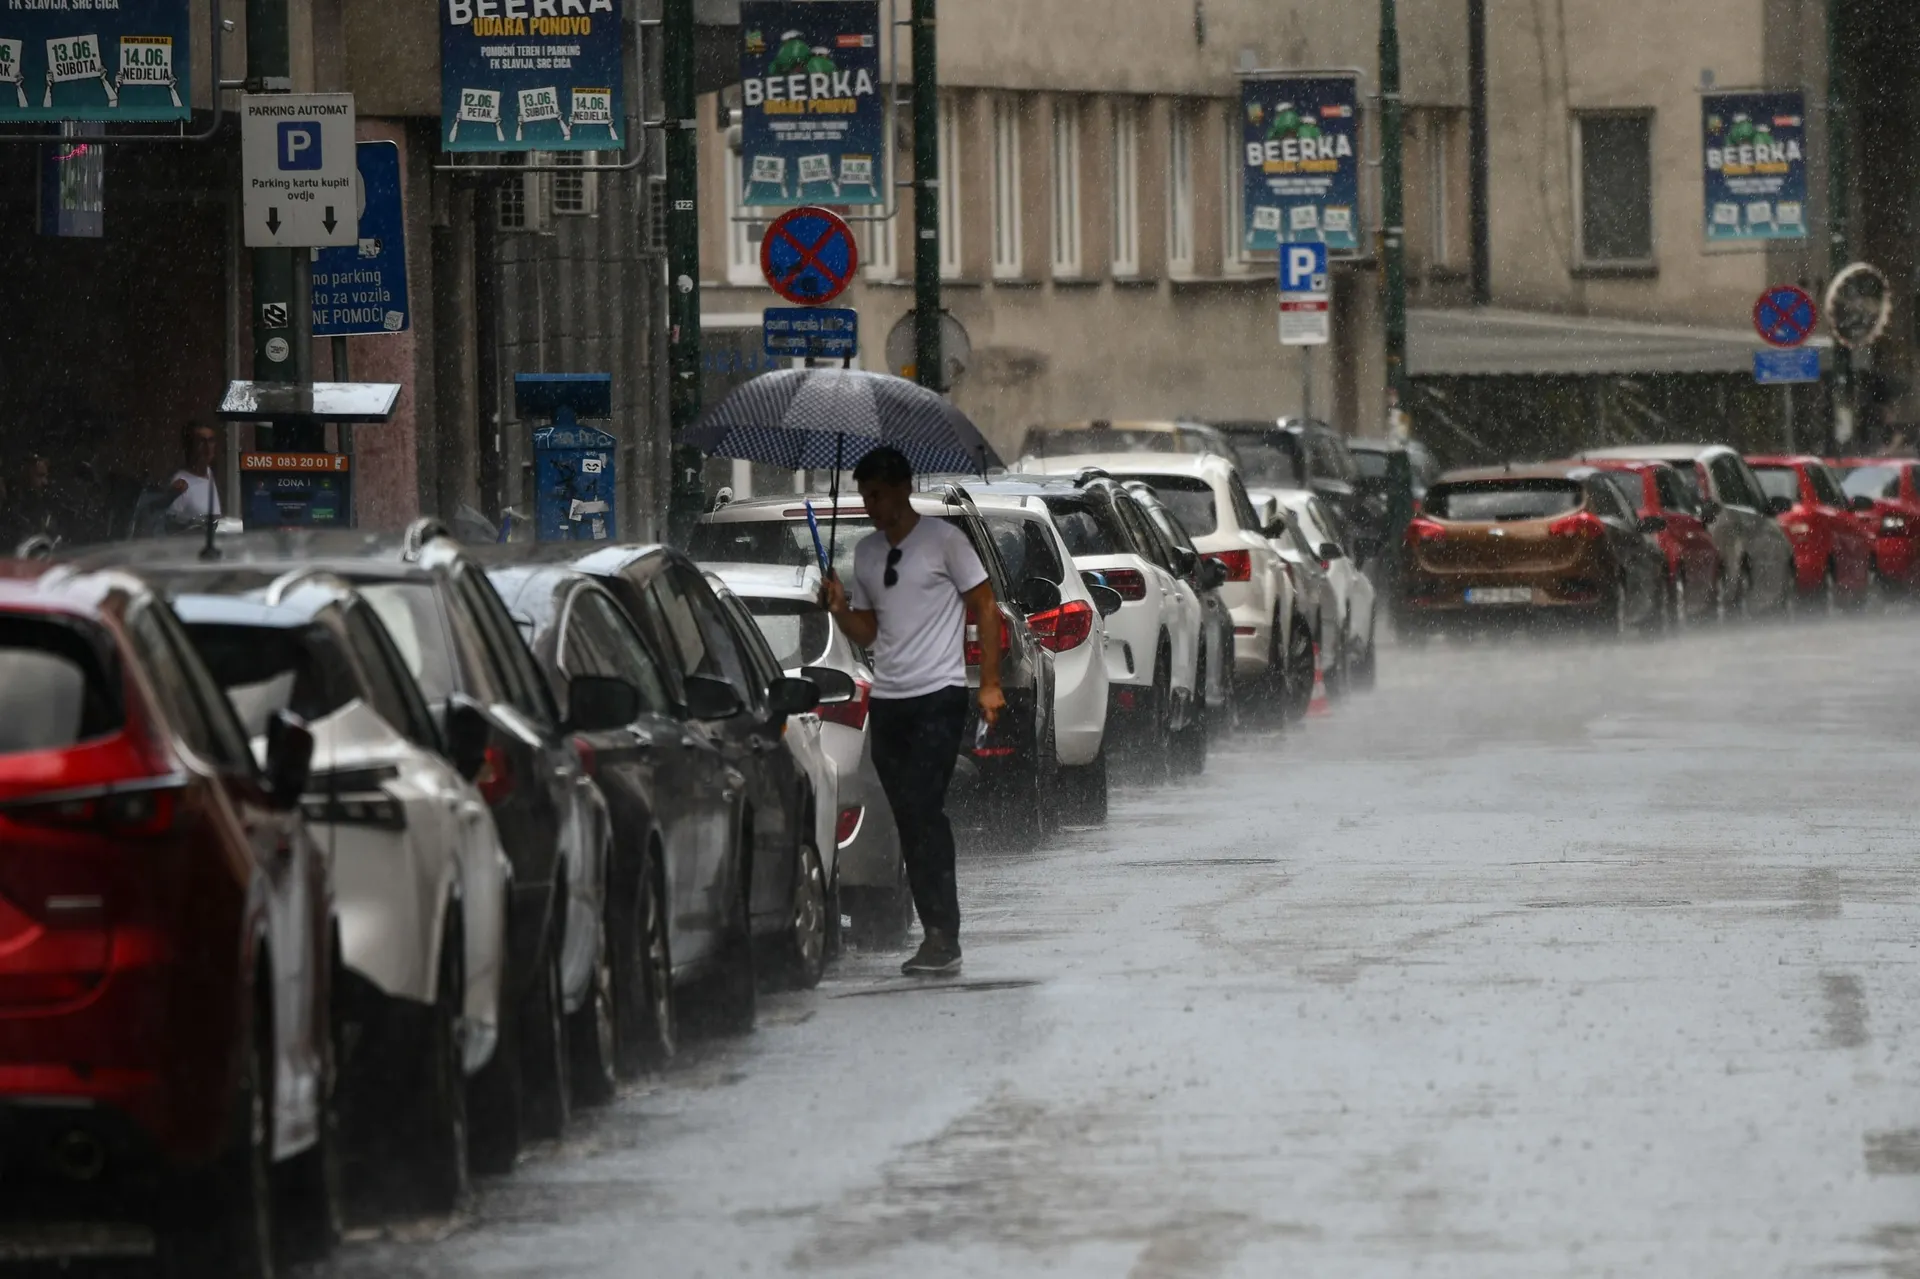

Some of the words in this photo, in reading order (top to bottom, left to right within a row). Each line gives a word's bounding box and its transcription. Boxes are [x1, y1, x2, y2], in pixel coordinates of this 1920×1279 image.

[9, 0, 22, 10] FK
[473, 17, 525, 36] UDARA
[530, 16, 591, 36] PONOVO
[52, 41, 96, 62] 13.06.
[124, 48, 168, 66] 14.06.
[516, 45, 540, 56] TEREN
[547, 45, 580, 56] PARKING
[56, 60, 96, 76] SUBOTA
[490, 58, 500, 69] FK
[123, 67, 170, 80] NEDJELJA
[744, 68, 873, 106] BEERKA
[463, 93, 495, 108] 12.06.
[522, 92, 555, 107] 13.06.
[575, 97, 608, 110] 14.06.
[249, 106, 295, 116] PARKING
[298, 105, 348, 115] AUTOMAT
[467, 107, 492, 118] PETAK
[525, 106, 555, 118] SUBOTA
[574, 110, 609, 121] NEDJELJA
[287, 130, 312, 162] P
[1246, 133, 1352, 166] BEERKA
[1706, 139, 1802, 170] BEERKA
[252, 178, 290, 189] Parking
[293, 178, 318, 187] kartu
[321, 177, 349, 189] kupiti
[287, 191, 315, 201] ovdje
[1289, 247, 1316, 286] P
[332, 269, 382, 288] parking
[333, 292, 348, 304] za
[352, 287, 391, 303] vozila
[333, 304, 384, 324] POMOĆI
[247, 456, 272, 468] SMS
[277, 457, 297, 467] 083
[300, 457, 313, 467] 20
[316, 458, 328, 467] 01
[278, 479, 304, 487] ZONA
